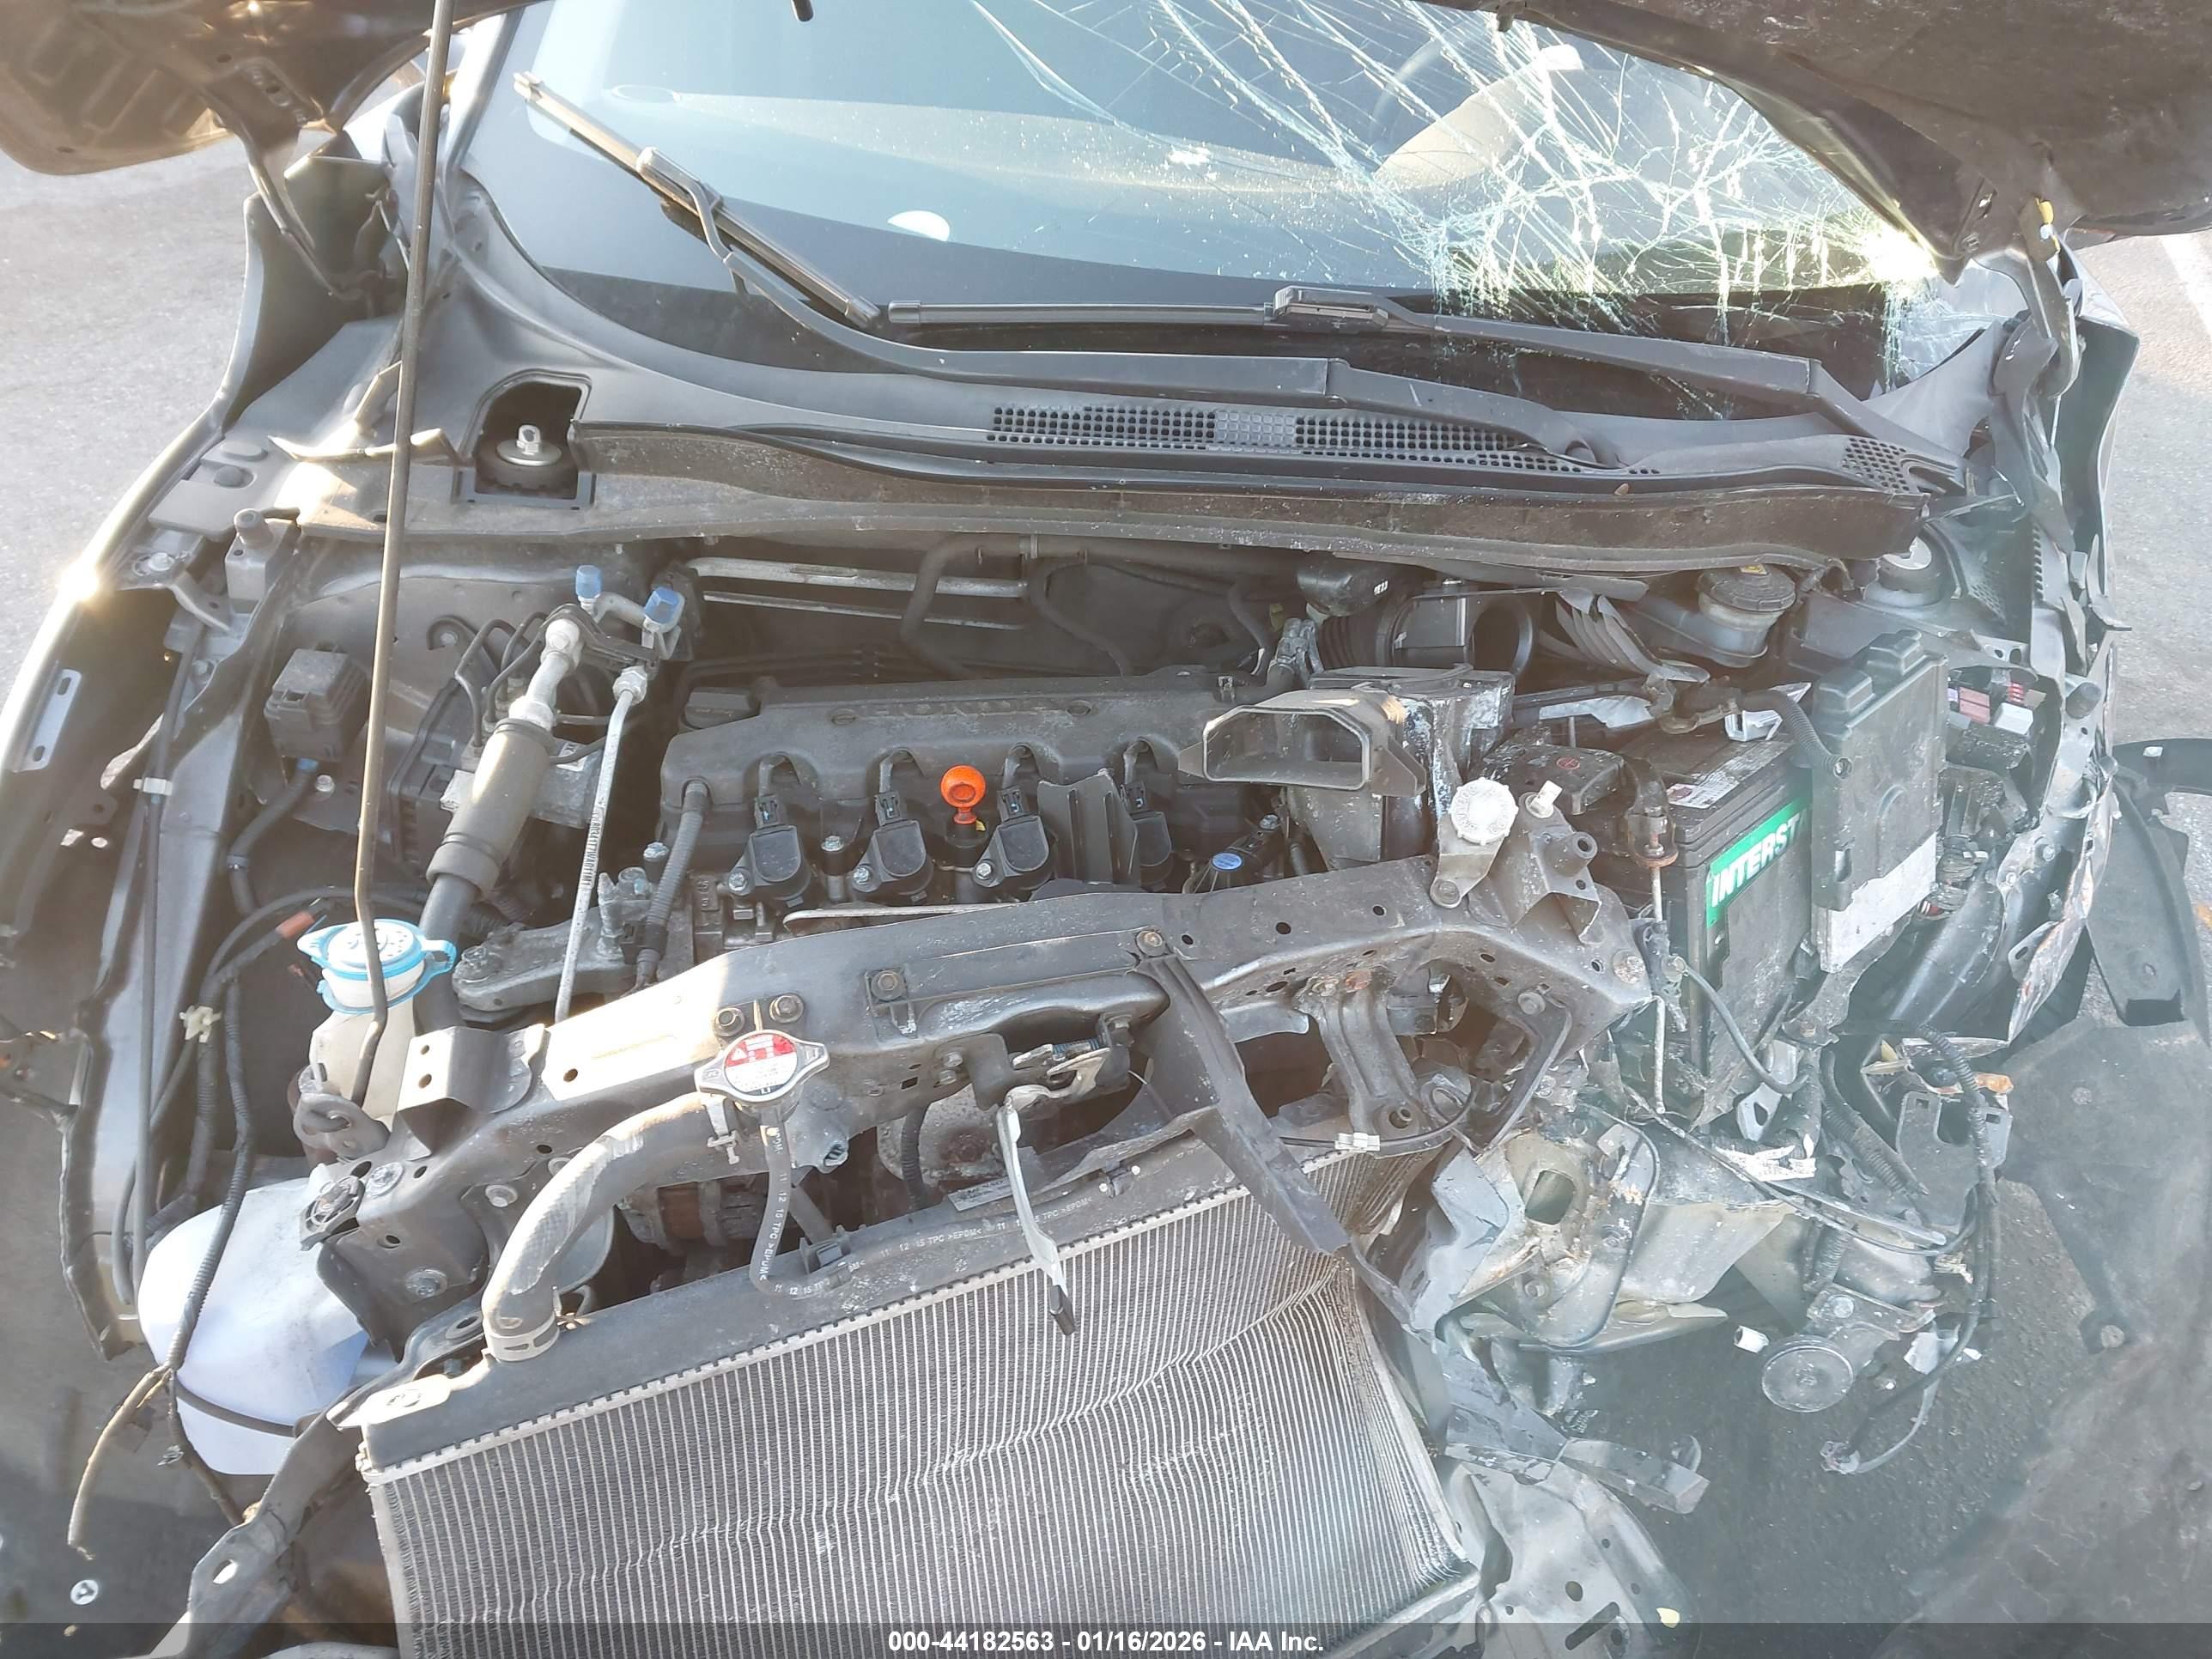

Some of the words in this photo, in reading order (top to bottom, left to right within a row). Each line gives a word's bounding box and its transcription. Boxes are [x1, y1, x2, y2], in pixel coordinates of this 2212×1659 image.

[1711, 808, 1807, 908] INTERST
[778, 1191, 787, 1203] 12
[769, 1222, 781, 1239] TPC
[789, 1286, 799, 1295] 12
[927, 1235, 945, 1244] TPC
